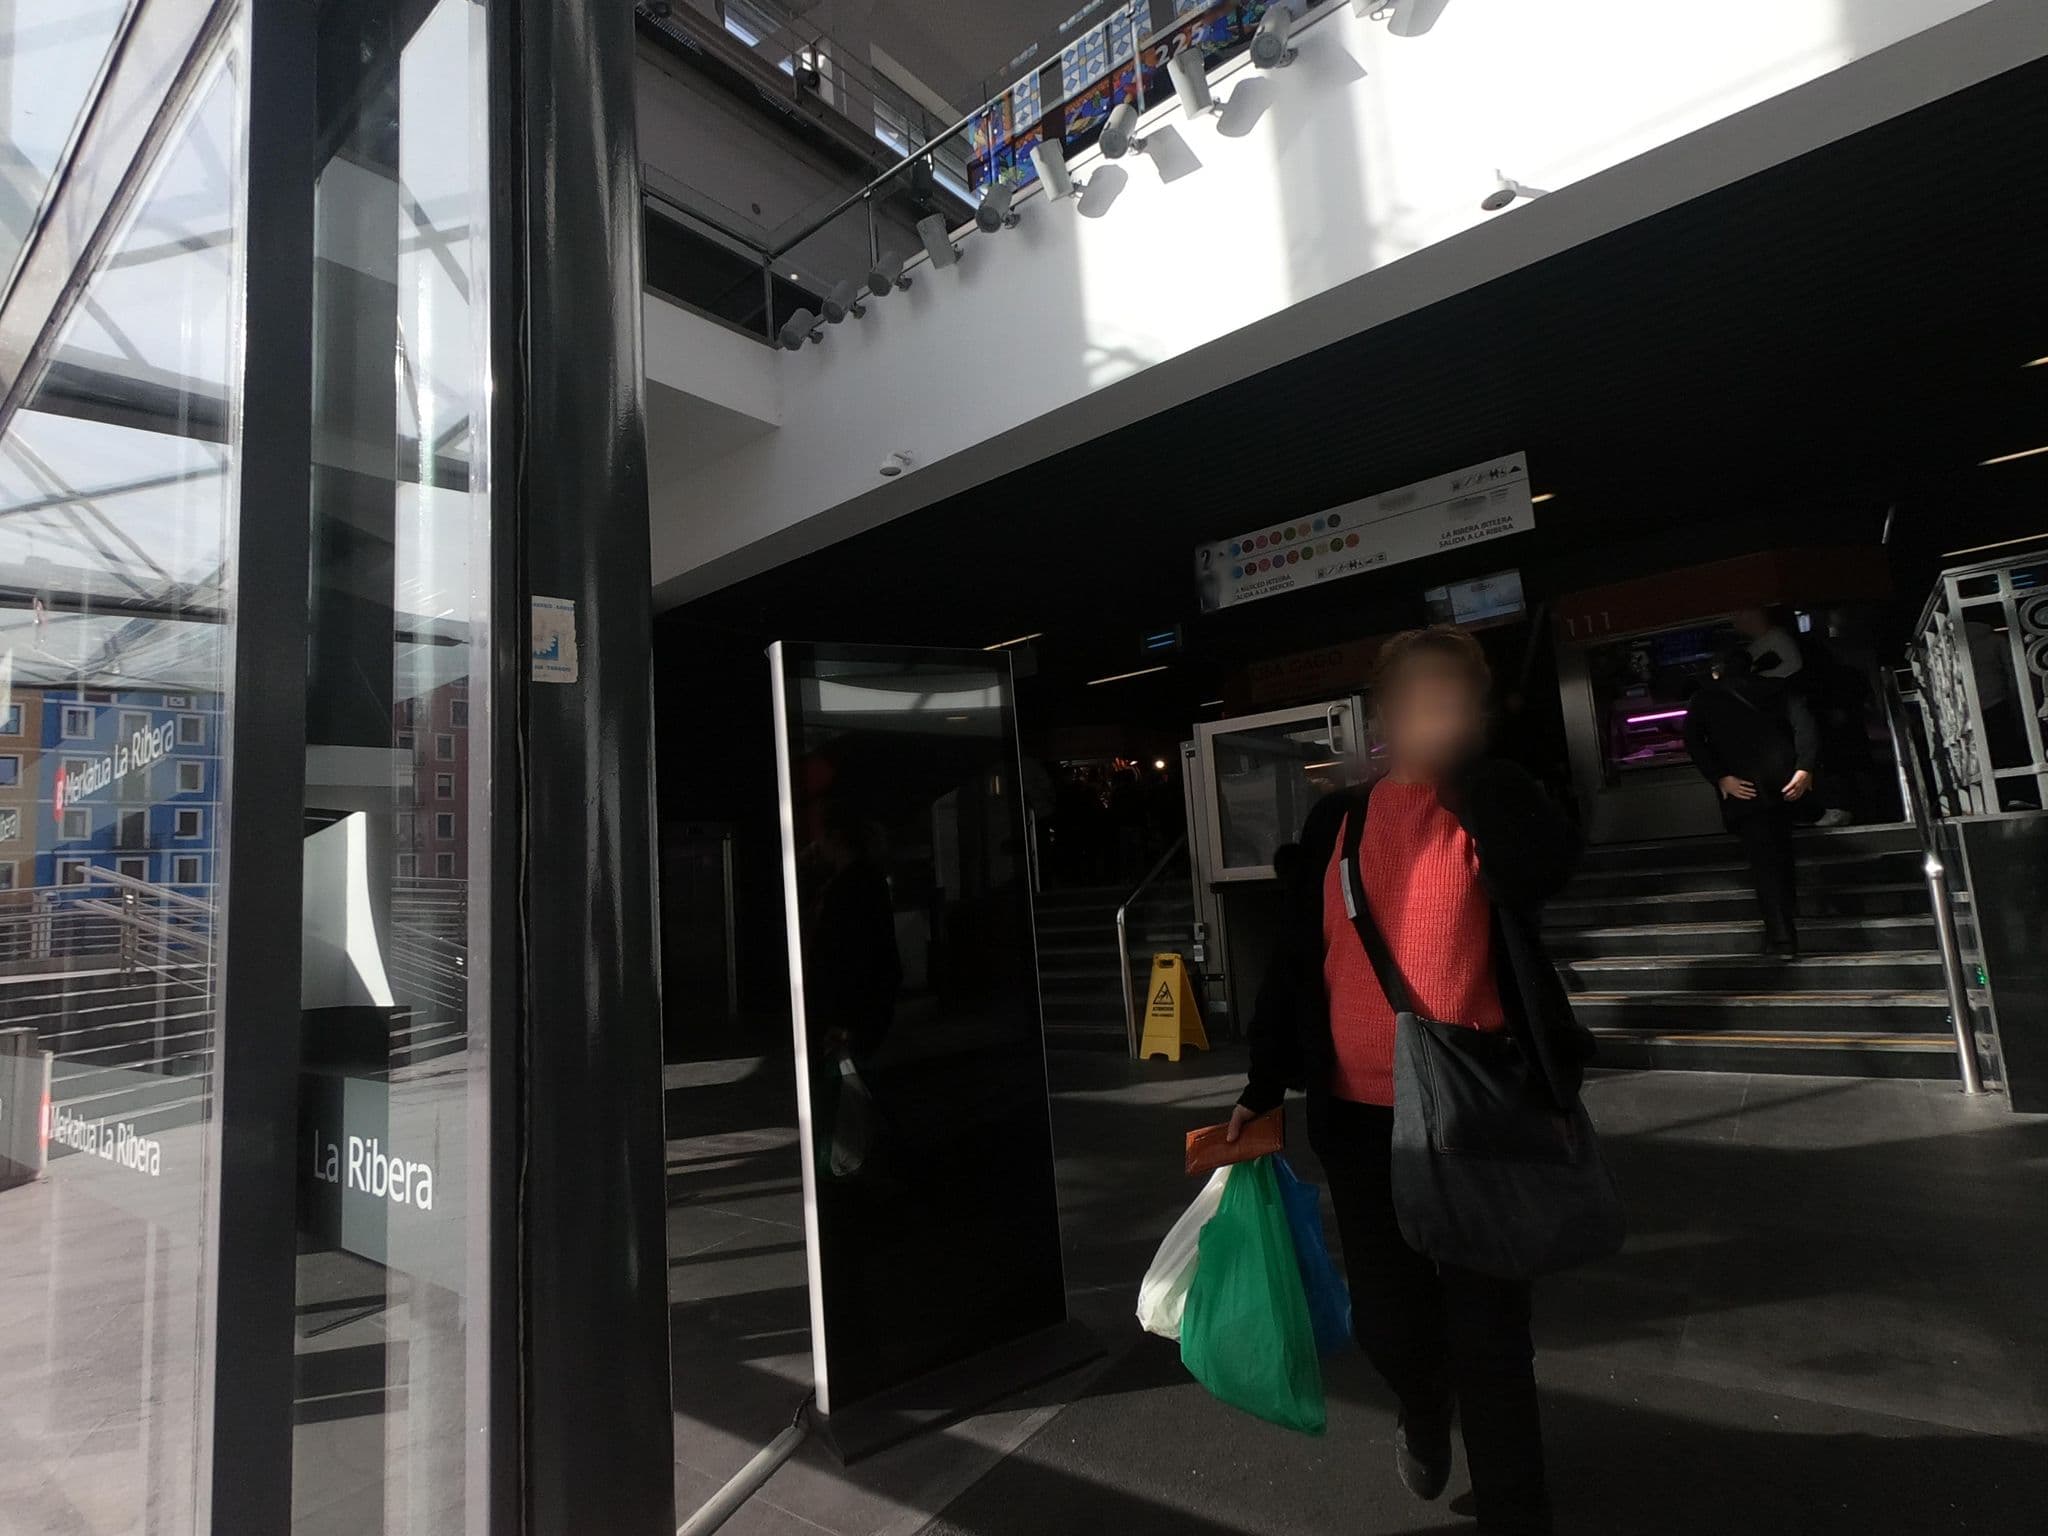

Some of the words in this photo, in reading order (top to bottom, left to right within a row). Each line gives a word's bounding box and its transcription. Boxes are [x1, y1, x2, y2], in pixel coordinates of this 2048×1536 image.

[1154, 20, 1204, 68] 225
[1566, 610, 1611, 638] 111
[64, 756, 112, 806] Merkatua
[113, 743, 128, 779] La
[131, 719, 174, 770] Ribera
[48, 1104, 97, 1155] Merkatua
[98, 1117, 114, 1161] La
[116, 1122, 161, 1177] Ribera
[313, 1128, 339, 1184] La
[347, 1135, 433, 1212] Ribera
